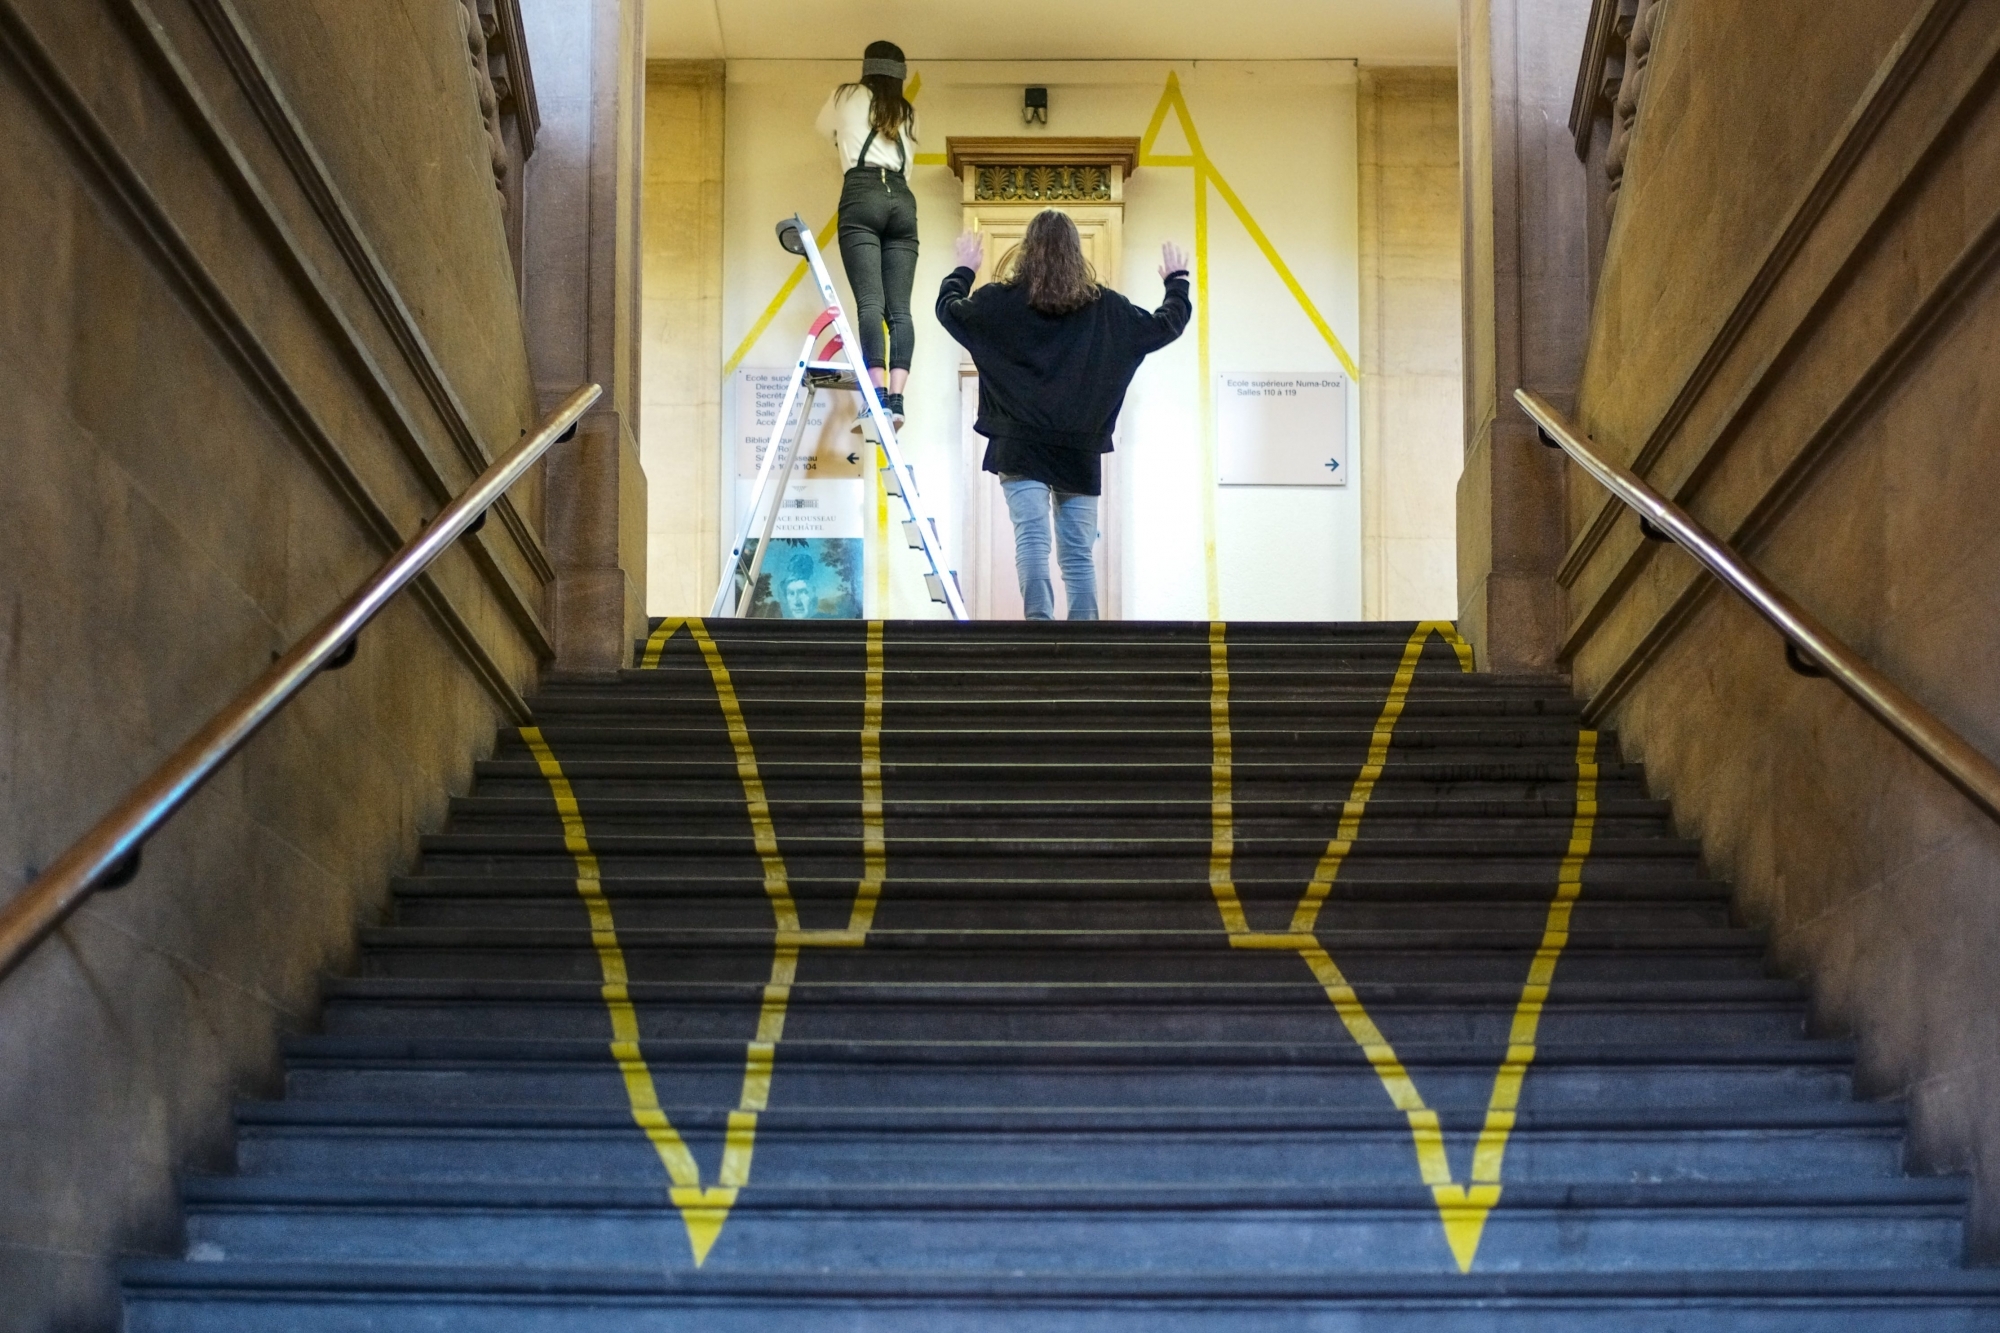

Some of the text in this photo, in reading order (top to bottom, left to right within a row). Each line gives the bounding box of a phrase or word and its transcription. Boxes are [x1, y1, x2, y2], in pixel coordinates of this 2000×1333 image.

[1227, 379, 1341, 389] Ecole supérieure Numa-Droz
[1237, 388, 1261, 396] Salles
[1277, 388, 1282, 396] à
[755, 418, 777, 426] Accè
[803, 463, 817, 471] 104
[776, 522, 825, 531] NEUCHÂTEL
